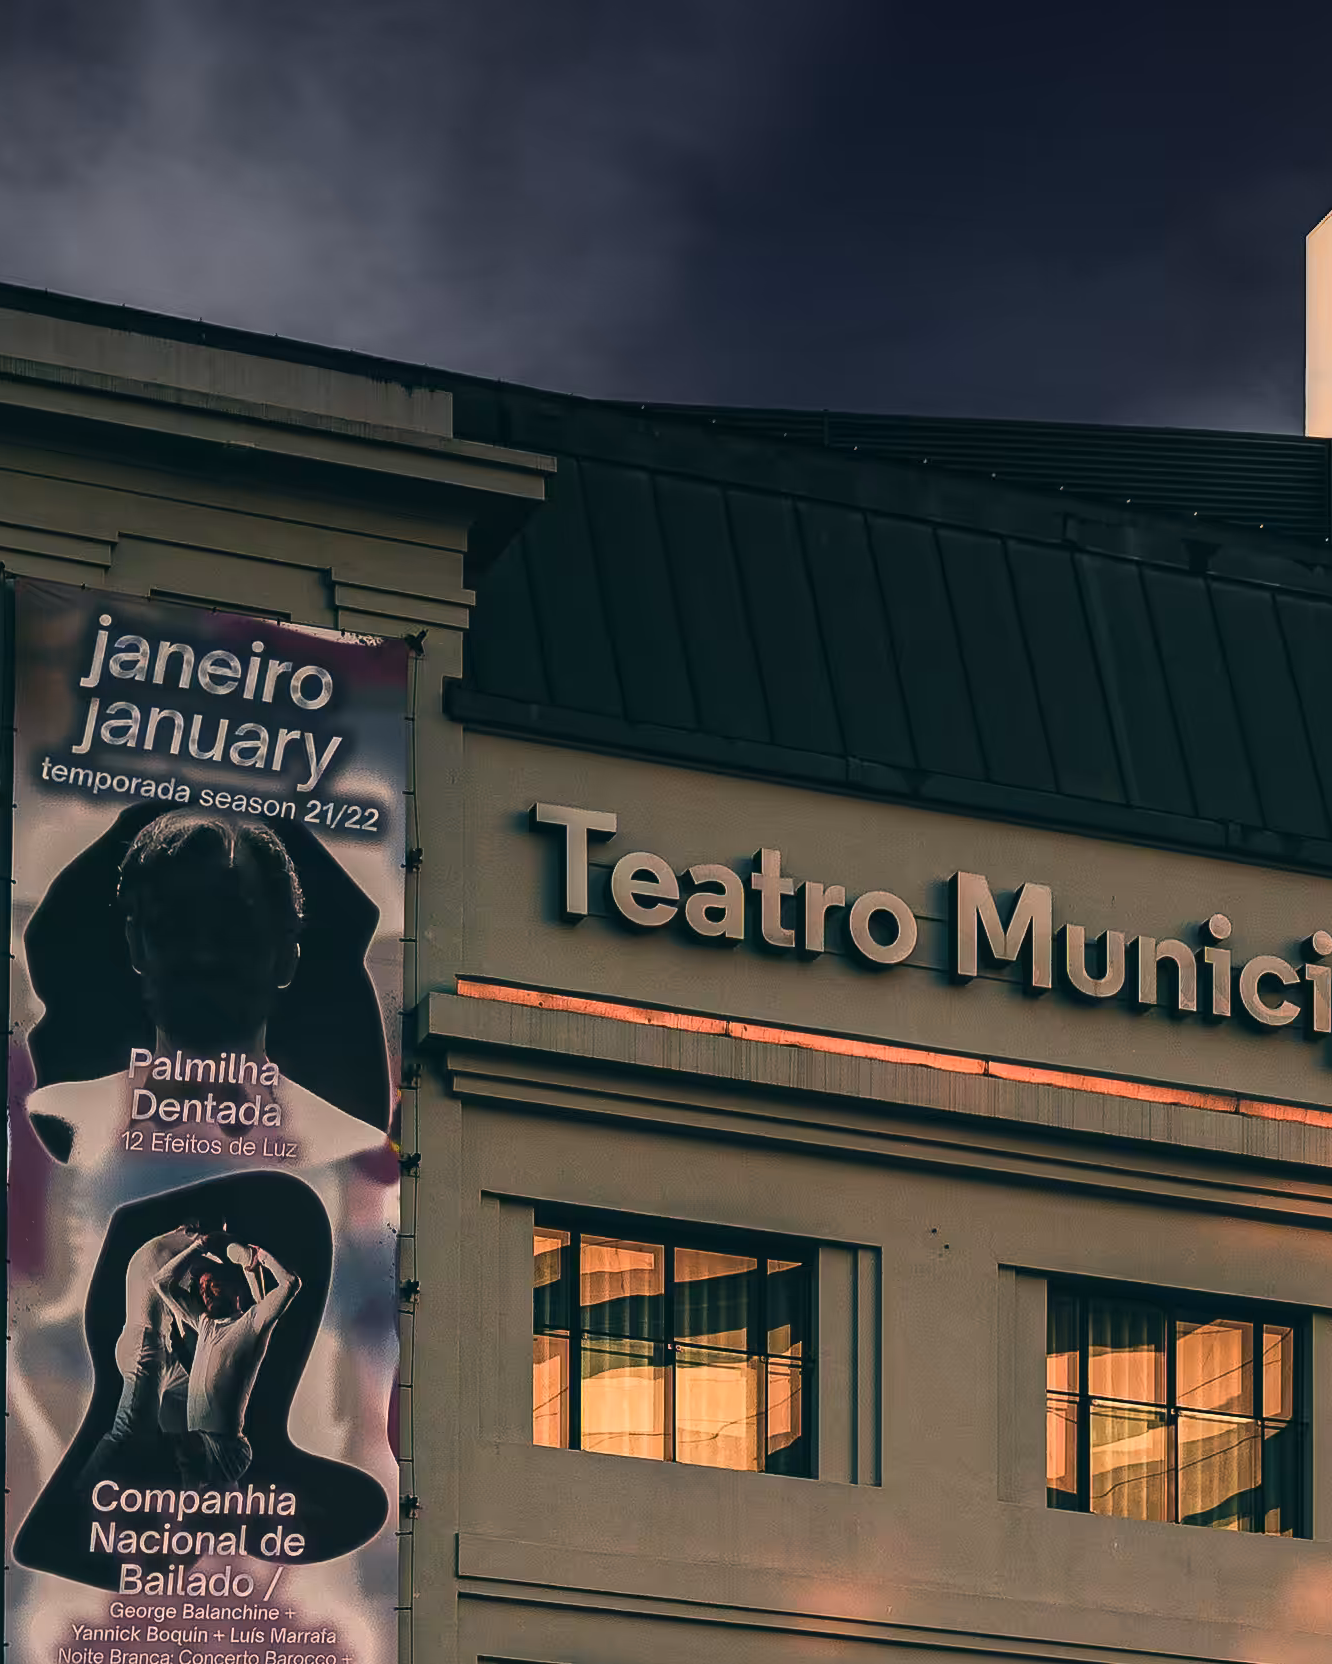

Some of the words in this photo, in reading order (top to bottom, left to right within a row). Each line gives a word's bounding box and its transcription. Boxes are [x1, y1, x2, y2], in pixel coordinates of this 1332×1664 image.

[79, 613, 334, 710] janeiro
[71, 697, 344, 795] january
[41, 756, 191, 803] temporada
[198, 786, 296, 820] season
[303, 799, 380, 832] 21/22
[531, 803, 917, 967] Teatro
[127, 1047, 281, 1088] Palmilha
[131, 1089, 284, 1129] Dentada
[121, 1131, 144, 1151] 12
[151, 1131, 223, 1155] Efeitos
[228, 1136, 256, 1156] de
[262, 1137, 298, 1158] Luz
[91, 1479, 296, 1522] Companhia
[89, 1521, 247, 1557] Nacional
[260, 1525, 306, 1557] de
[118, 1563, 255, 1599] Bailado
[261, 1565, 286, 1602] /
[110, 1601, 177, 1623] George
[182, 1603, 280, 1621] Balanchine
[284, 1606, 297, 1619] +
[71, 1623, 142, 1642] Yannick
[146, 1625, 208, 1647] Boquin
[212, 1629, 226, 1643] +
[230, 1626, 265, 1644] Luís
[270, 1627, 336, 1644] Marrafa
[58, 1647, 105, 1664] Noite
[341, 1654, 355, 1664] +
